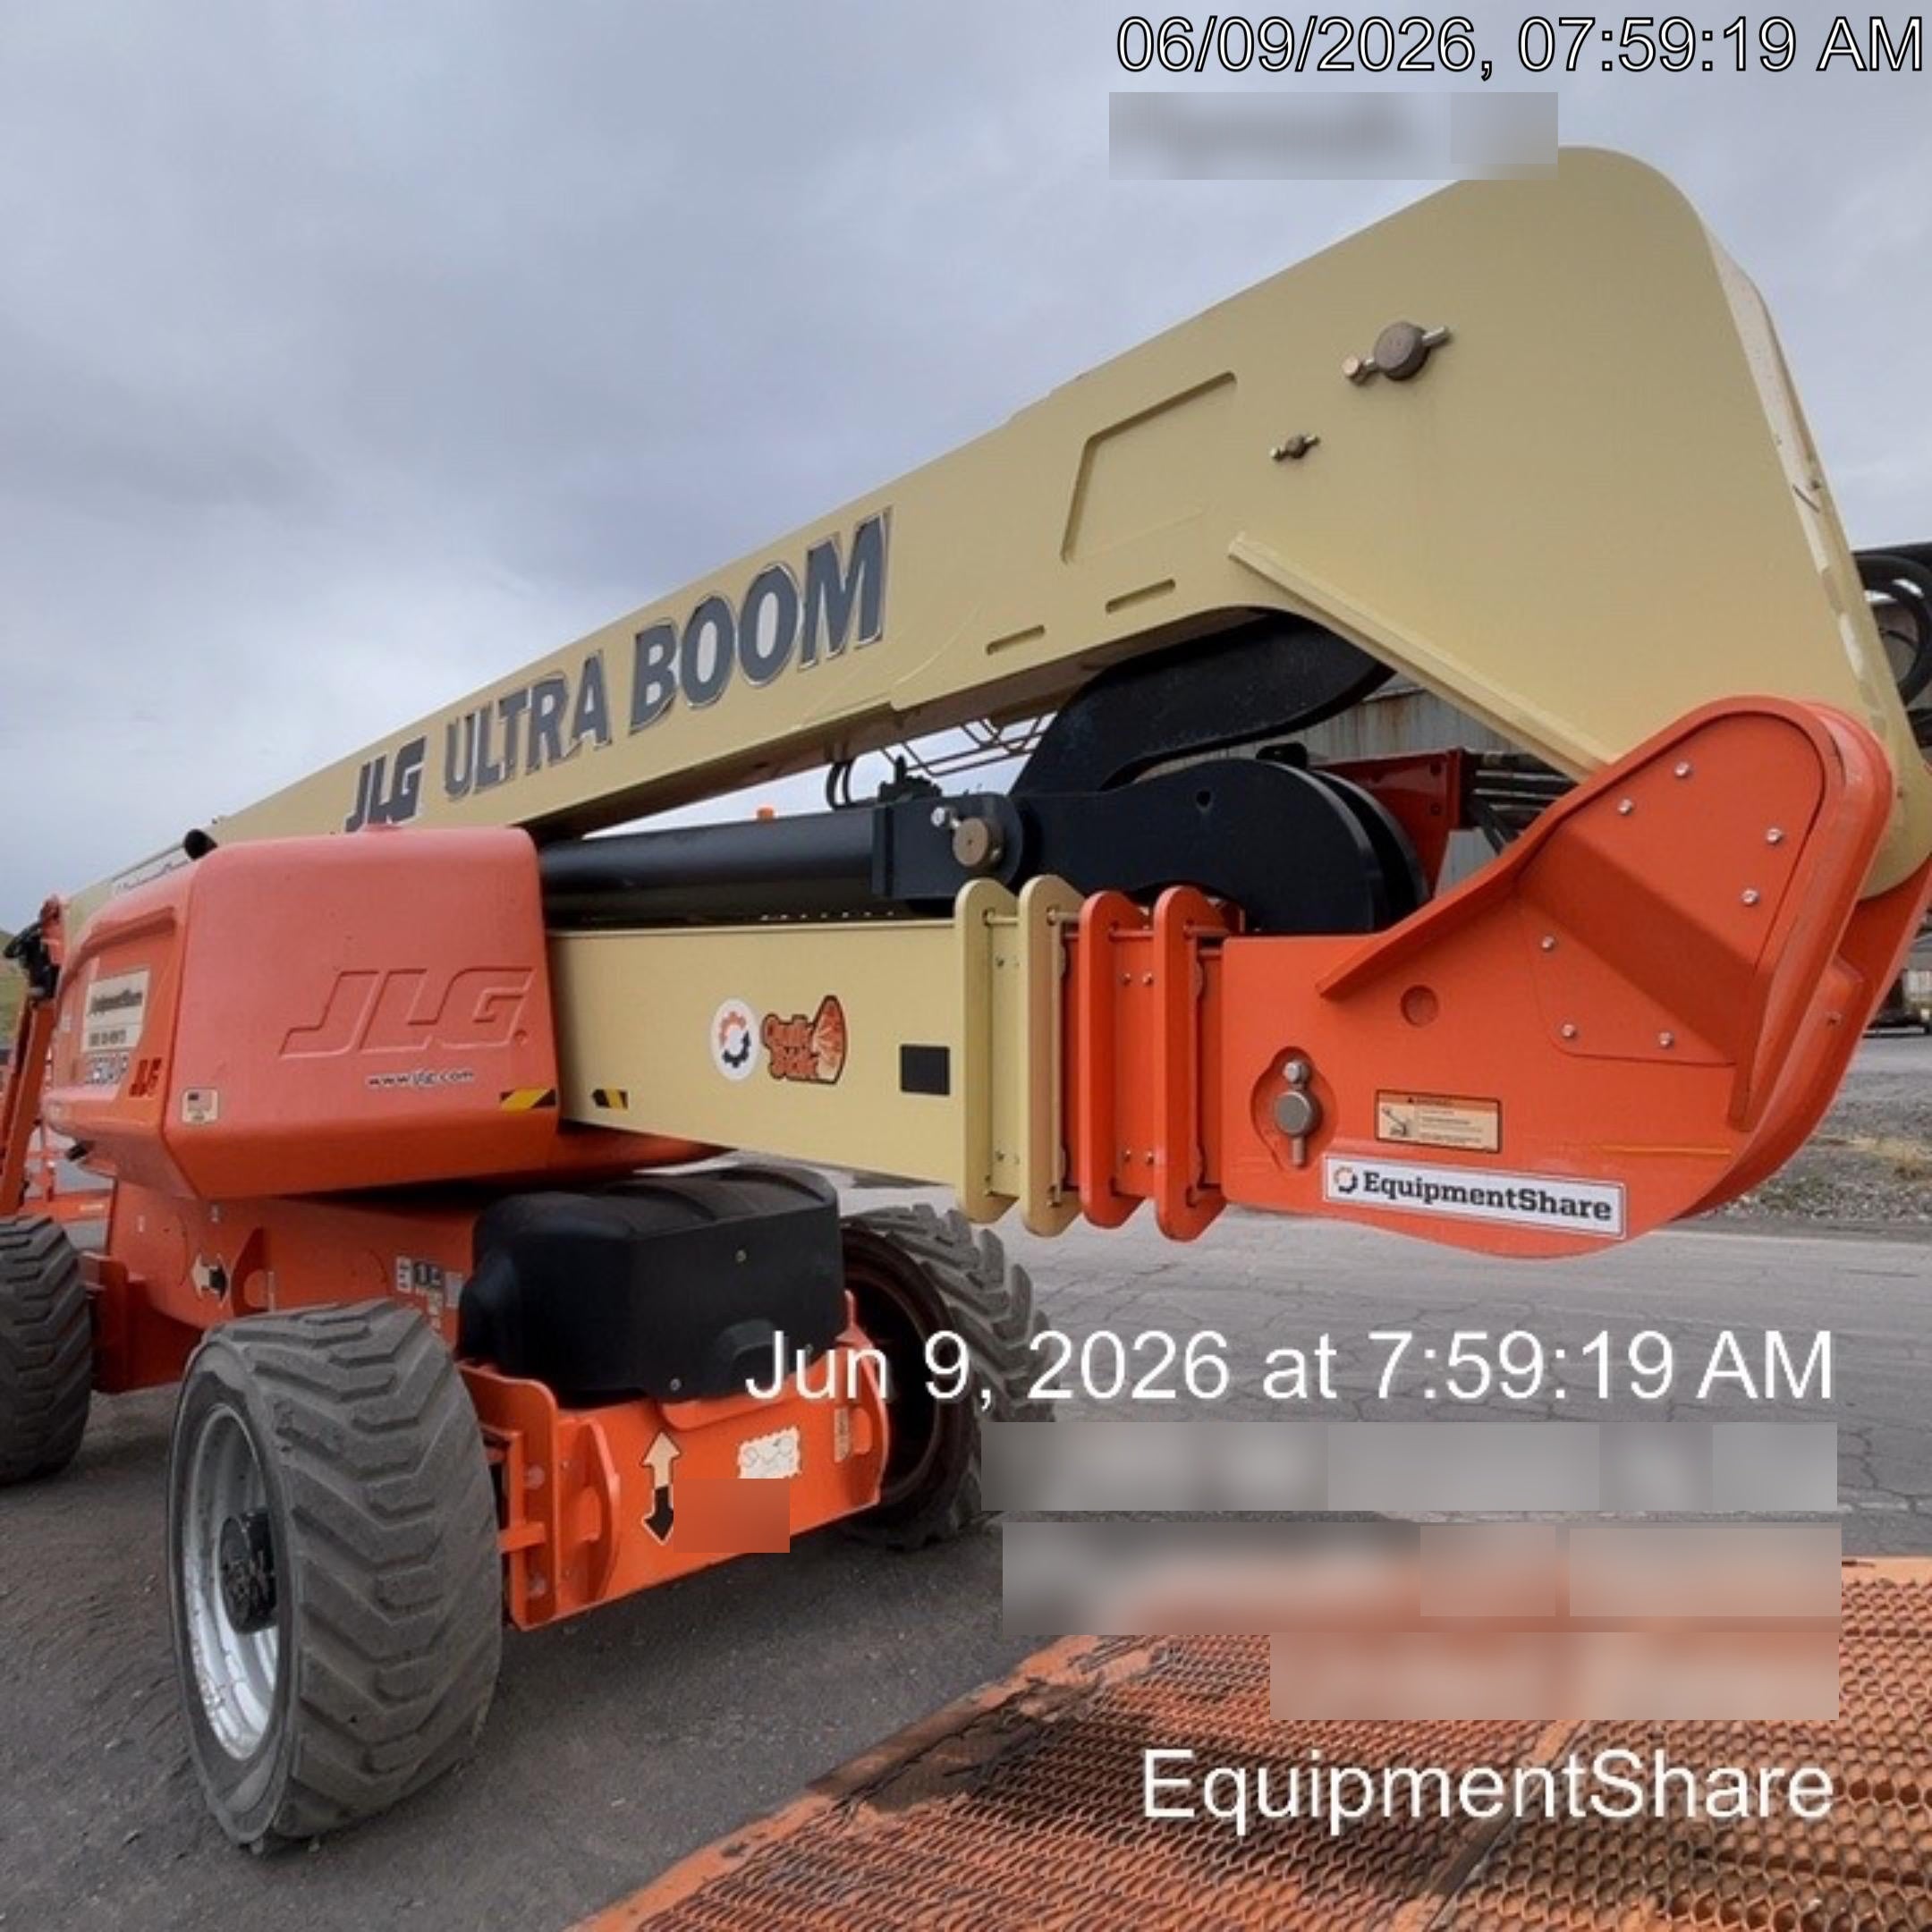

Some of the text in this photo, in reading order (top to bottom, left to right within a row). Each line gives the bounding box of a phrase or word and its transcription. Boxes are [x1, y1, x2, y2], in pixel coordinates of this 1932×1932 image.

[345, 506, 892, 834] JLG ULTRA BOOM
[279, 967, 534, 1058] JLG
[1361, 1171, 1613, 1222] EquipmentShare
